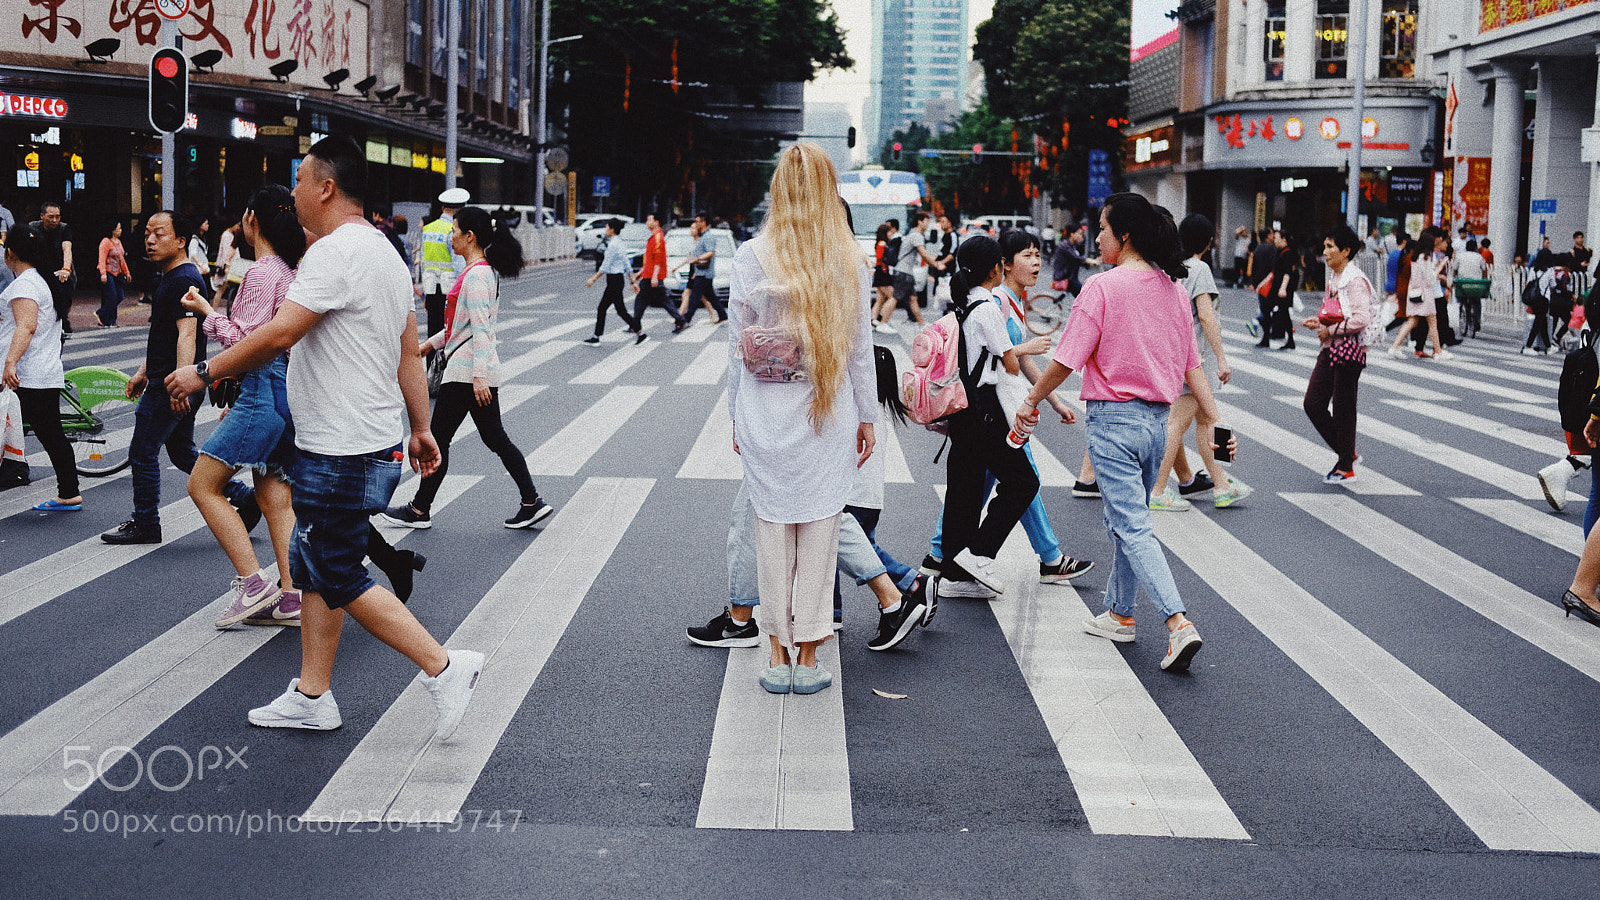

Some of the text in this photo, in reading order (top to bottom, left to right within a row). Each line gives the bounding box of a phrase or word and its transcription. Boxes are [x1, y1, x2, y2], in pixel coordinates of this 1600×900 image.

[10, 95, 67, 117] PEPCO
[190, 148, 197, 162] 9
[1391, 183, 1423, 191] HOT POT
